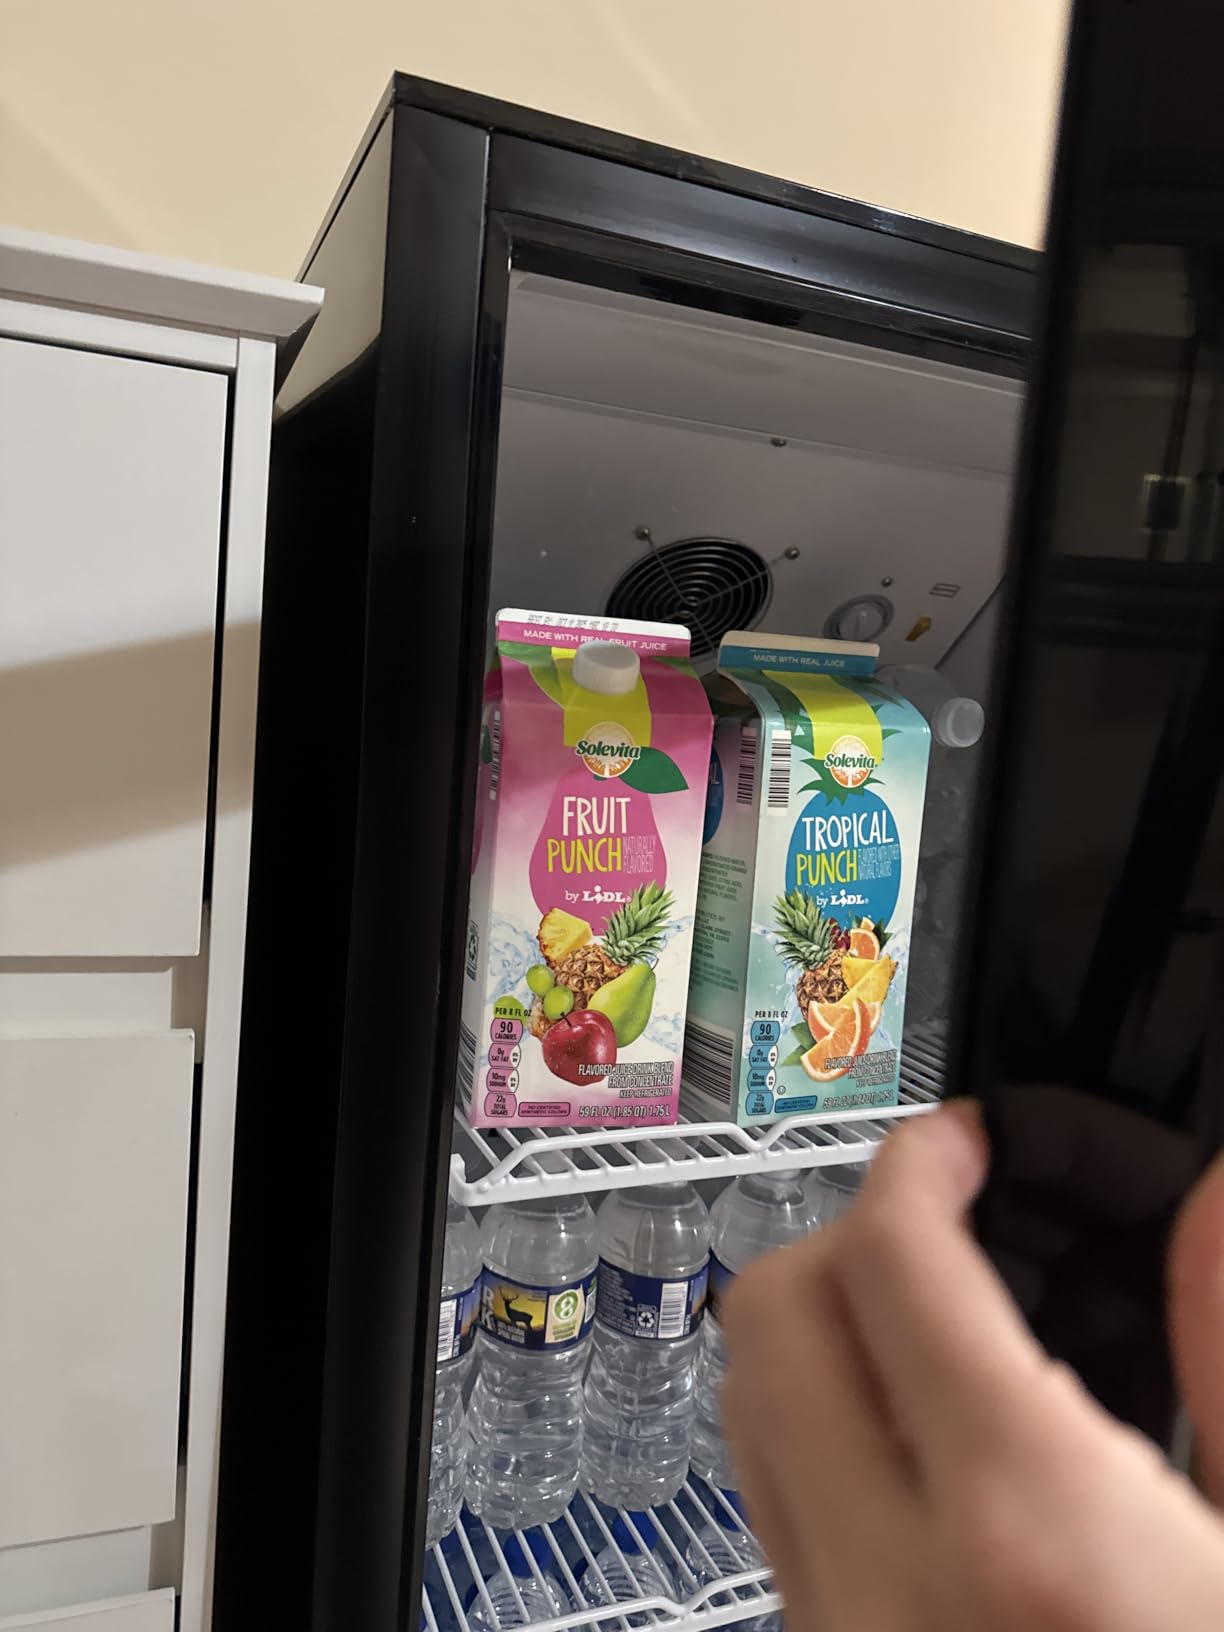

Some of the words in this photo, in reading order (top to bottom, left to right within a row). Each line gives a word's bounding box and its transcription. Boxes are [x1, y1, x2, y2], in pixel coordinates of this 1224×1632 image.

[523, 629, 548, 640] MADE
[553, 632, 579, 643] WITH
[639, 640, 669, 651] JUICE
[752, 653, 777, 663] MADE
[778, 655, 800, 665] WITH
[799, 657, 821, 667] REAL
[822, 659, 846, 668] JUICE
[576, 739, 641, 759] Solevita
[824, 753, 876, 769] Solevita
[562, 796, 631, 836] FRUIT
[801, 809, 894, 852] TROPICAL
[546, 837, 623, 874] PUNCH
[796, 848, 858, 887] PUNCH
[564, 890, 580, 904] by
[816, 895, 829, 908] by
[495, 1006, 505, 1016] PER
[508, 1008, 514, 1016] 8
[514, 1008, 522, 1017] FL
[523, 1008, 532, 1017] OZ
[754, 1010, 766, 1018] PER
[772, 1010, 780, 1018] FL
[780, 1010, 789, 1018] OZ
[499, 1021, 514, 1033] 90
[759, 1023, 772, 1035] 90
[494, 1033, 517, 1041] CALORIES
[578, 1063, 612, 1076] FLAVORED
[612, 1063, 632, 1076] JUICE
[632, 1062, 654, 1075] DRINK
[653, 1060, 675, 1074] BLEND
[607, 1075, 629, 1088] FROM
[629, 1073, 674, 1088] CONCENTRATE
[619, 1089, 634, 1098] KEEP
[634, 1087, 673, 1098] REFRIGERATED
[579, 1106, 591, 1117] 59
[590, 1106, 600, 1117] FL
[601, 1106, 612, 1117] OZ
